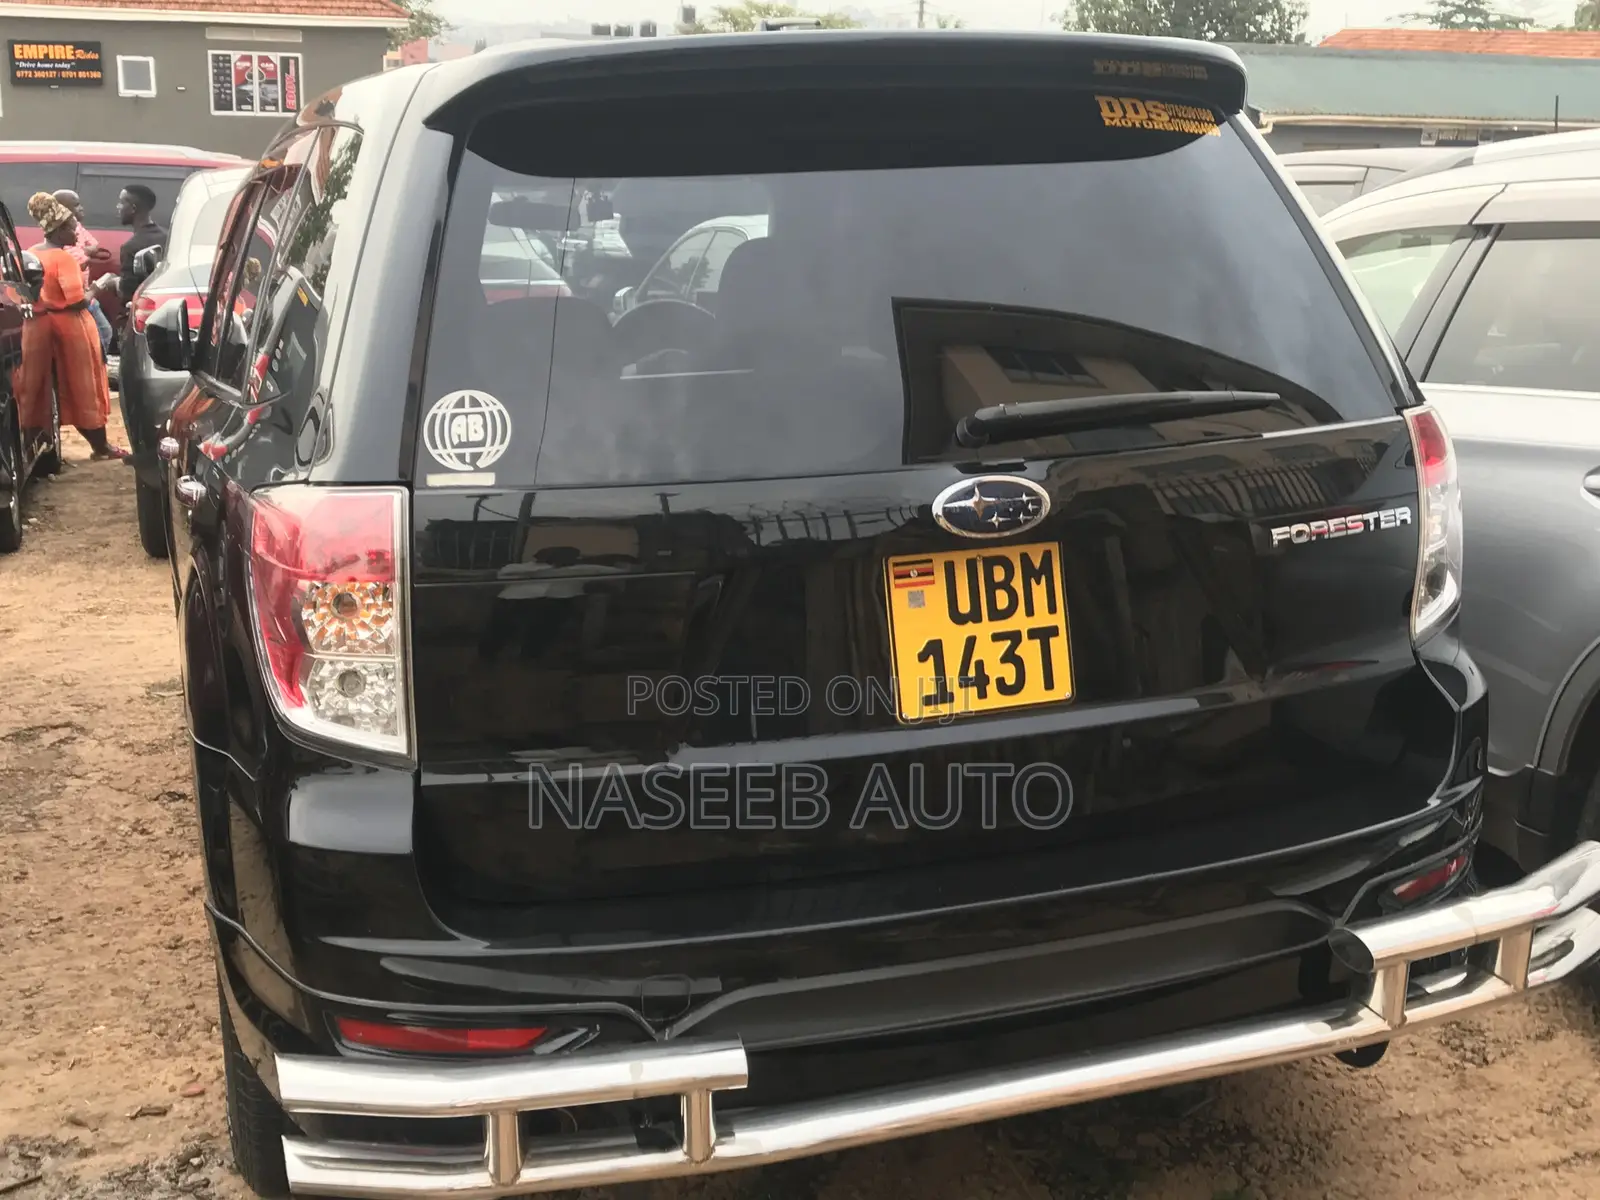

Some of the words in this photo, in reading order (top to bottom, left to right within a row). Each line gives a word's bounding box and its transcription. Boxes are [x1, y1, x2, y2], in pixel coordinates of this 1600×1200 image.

[13, 44, 75, 60] EMPIRE
[36, 61, 53, 69] home
[16, 70, 33, 78] 0772
[1094, 95, 1170, 121] DDS
[1103, 117, 1174, 131] MOTORS
[450, 414, 485, 446] AB
[1270, 506, 1412, 547] FORESTER
[943, 549, 1058, 626] UBM
[916, 625, 1060, 707] 143T
